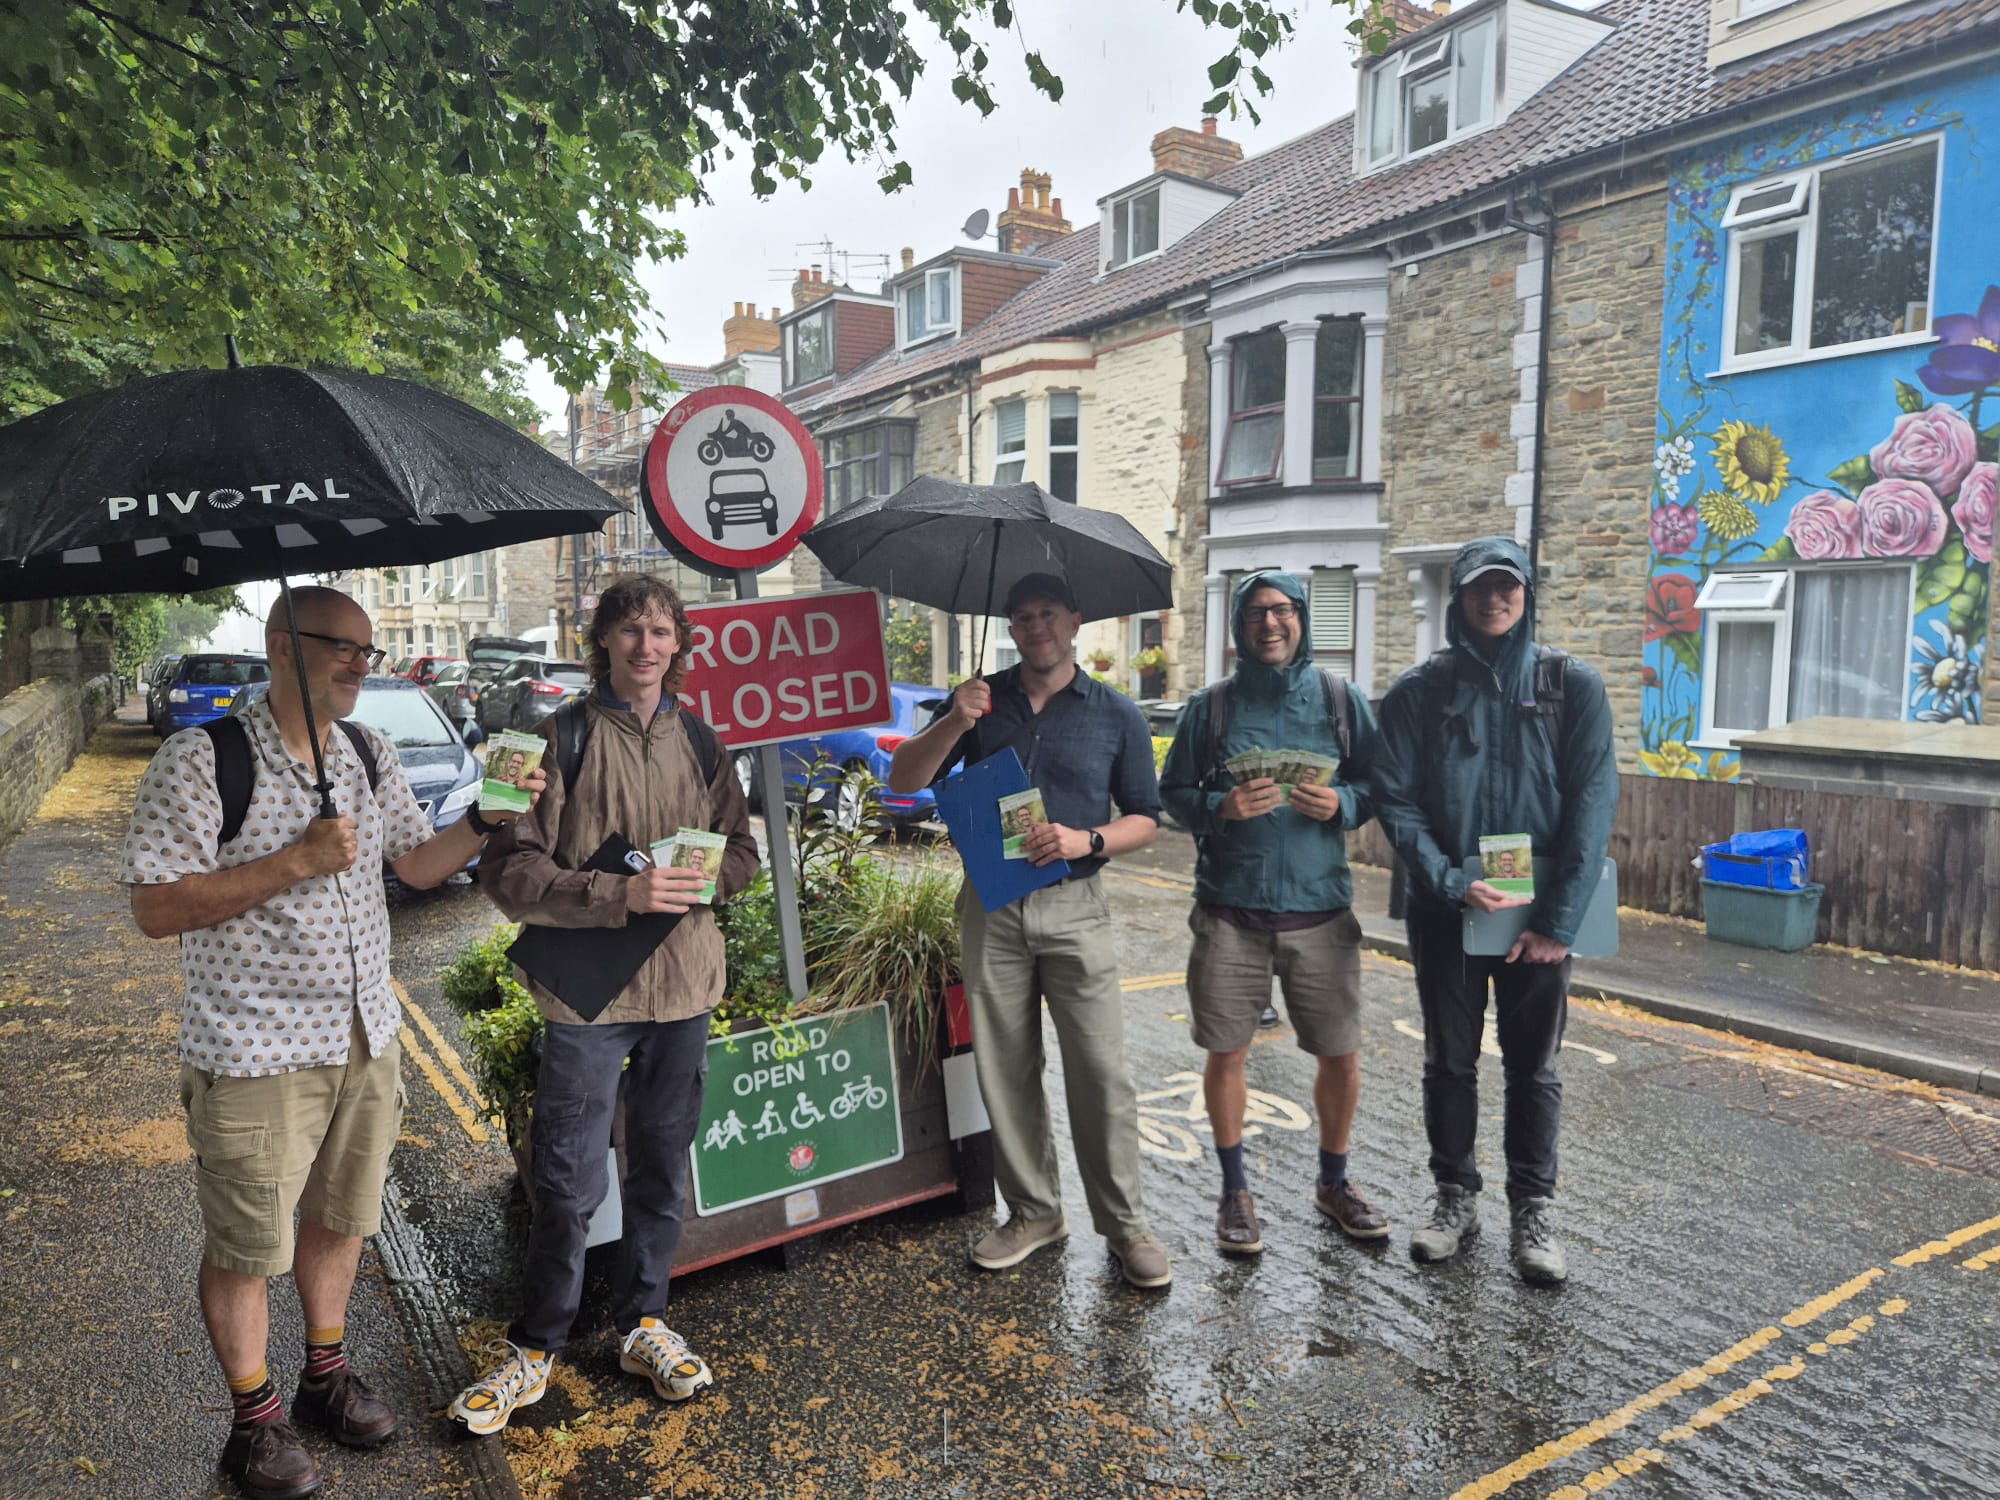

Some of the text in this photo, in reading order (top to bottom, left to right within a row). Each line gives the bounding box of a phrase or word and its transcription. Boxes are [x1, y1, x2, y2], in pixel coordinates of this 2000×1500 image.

[105, 478, 350, 521] PIVOTAL
[685, 612, 840, 671] ROAD
[733, 1049, 851, 1096] OPEN TO
